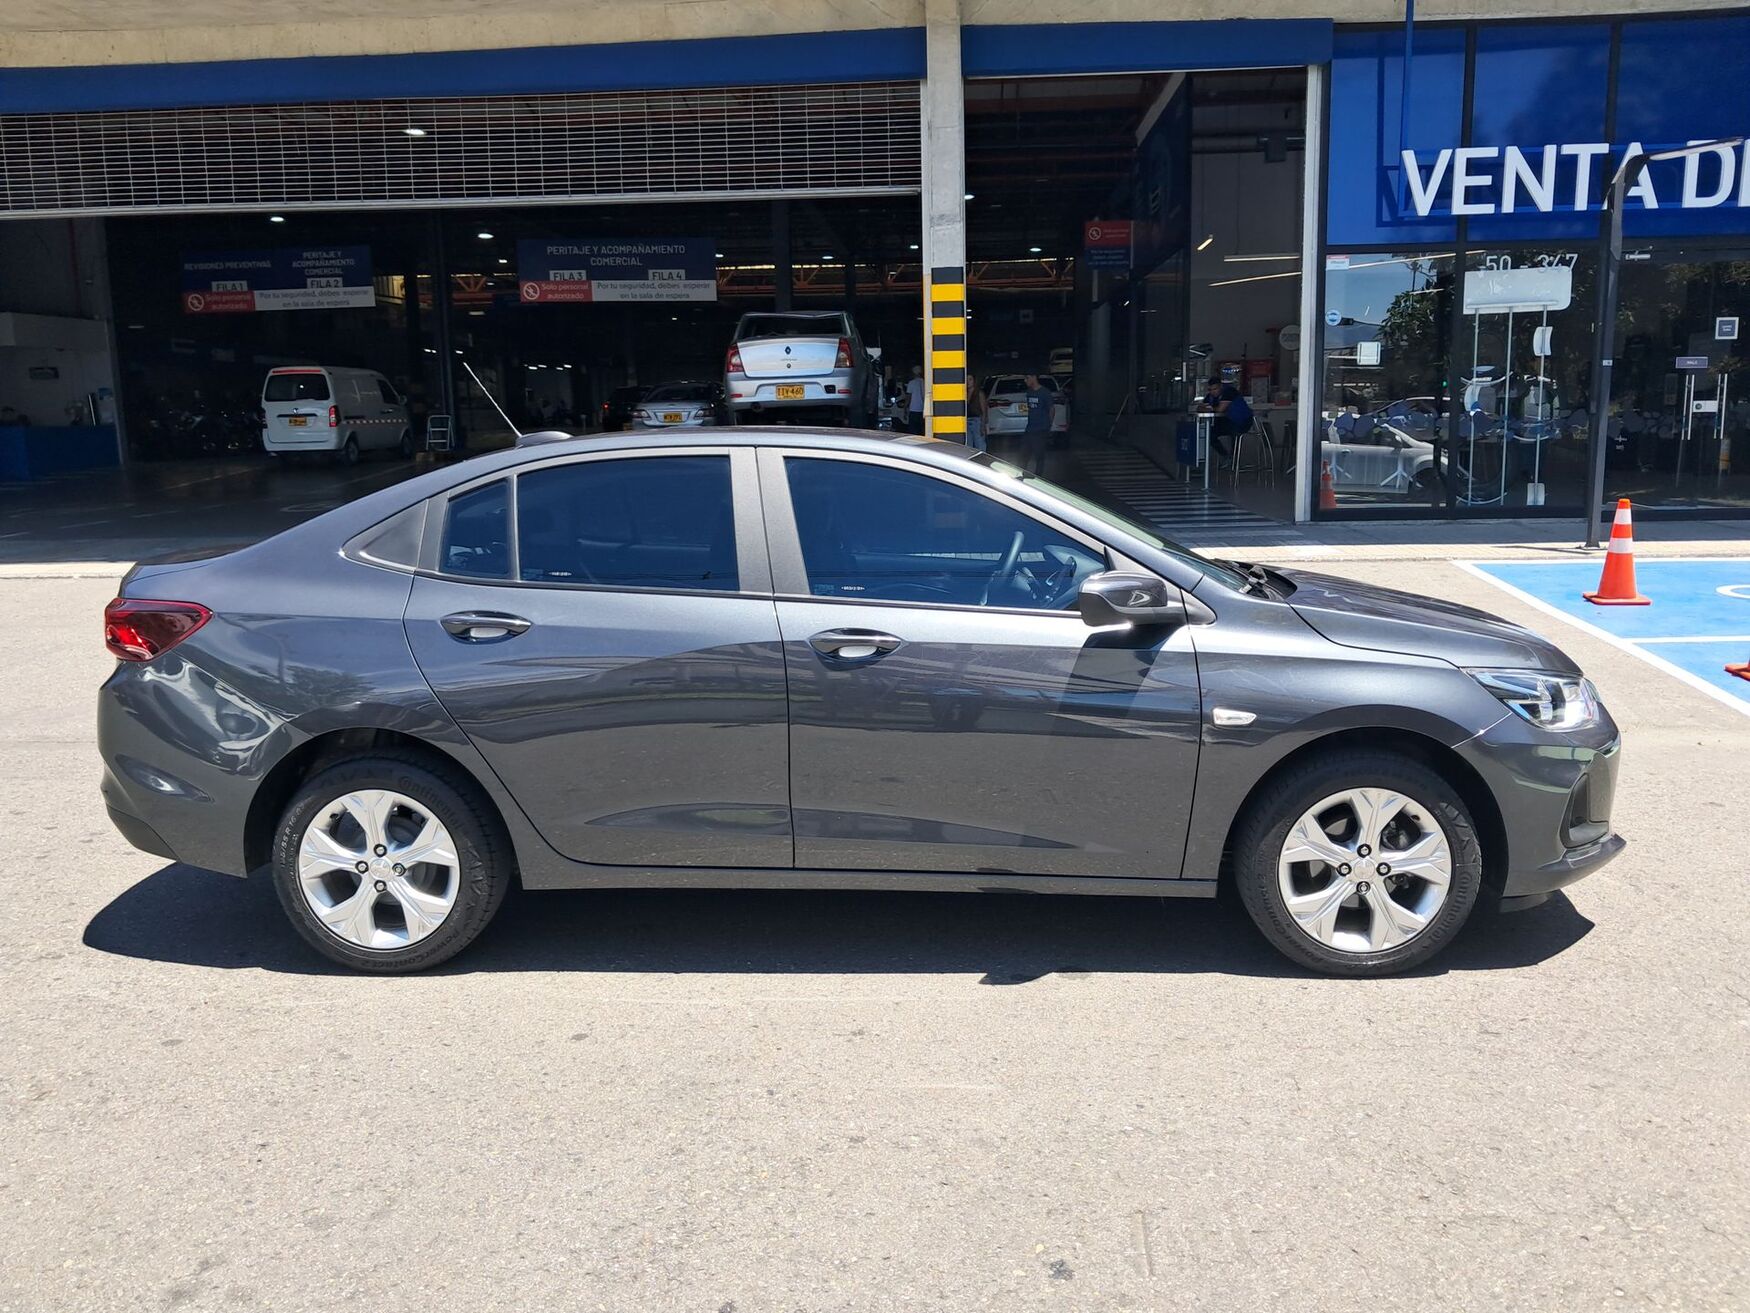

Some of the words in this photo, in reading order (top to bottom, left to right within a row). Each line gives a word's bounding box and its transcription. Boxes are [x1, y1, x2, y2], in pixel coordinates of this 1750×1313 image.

[1401, 142, 1660, 217] VENTA
[1681, 138, 1750, 209] D
[546, 246, 591, 255] PERITAJE
[593, 246, 599, 255] Y
[601, 243, 686, 254] ACOMPAÑAMIENTO
[590, 257, 643, 266] COMERCIAL
[1486, 254, 1512, 270] 50
[553, 271, 575, 281] FILA
[577, 271, 584, 281] 3
[652, 271, 675, 281] FILA
[676, 271, 682, 281] 4
[216, 282, 238, 291] FILA
[310, 279, 329, 289] FILA
[333, 279, 340, 288] 2
